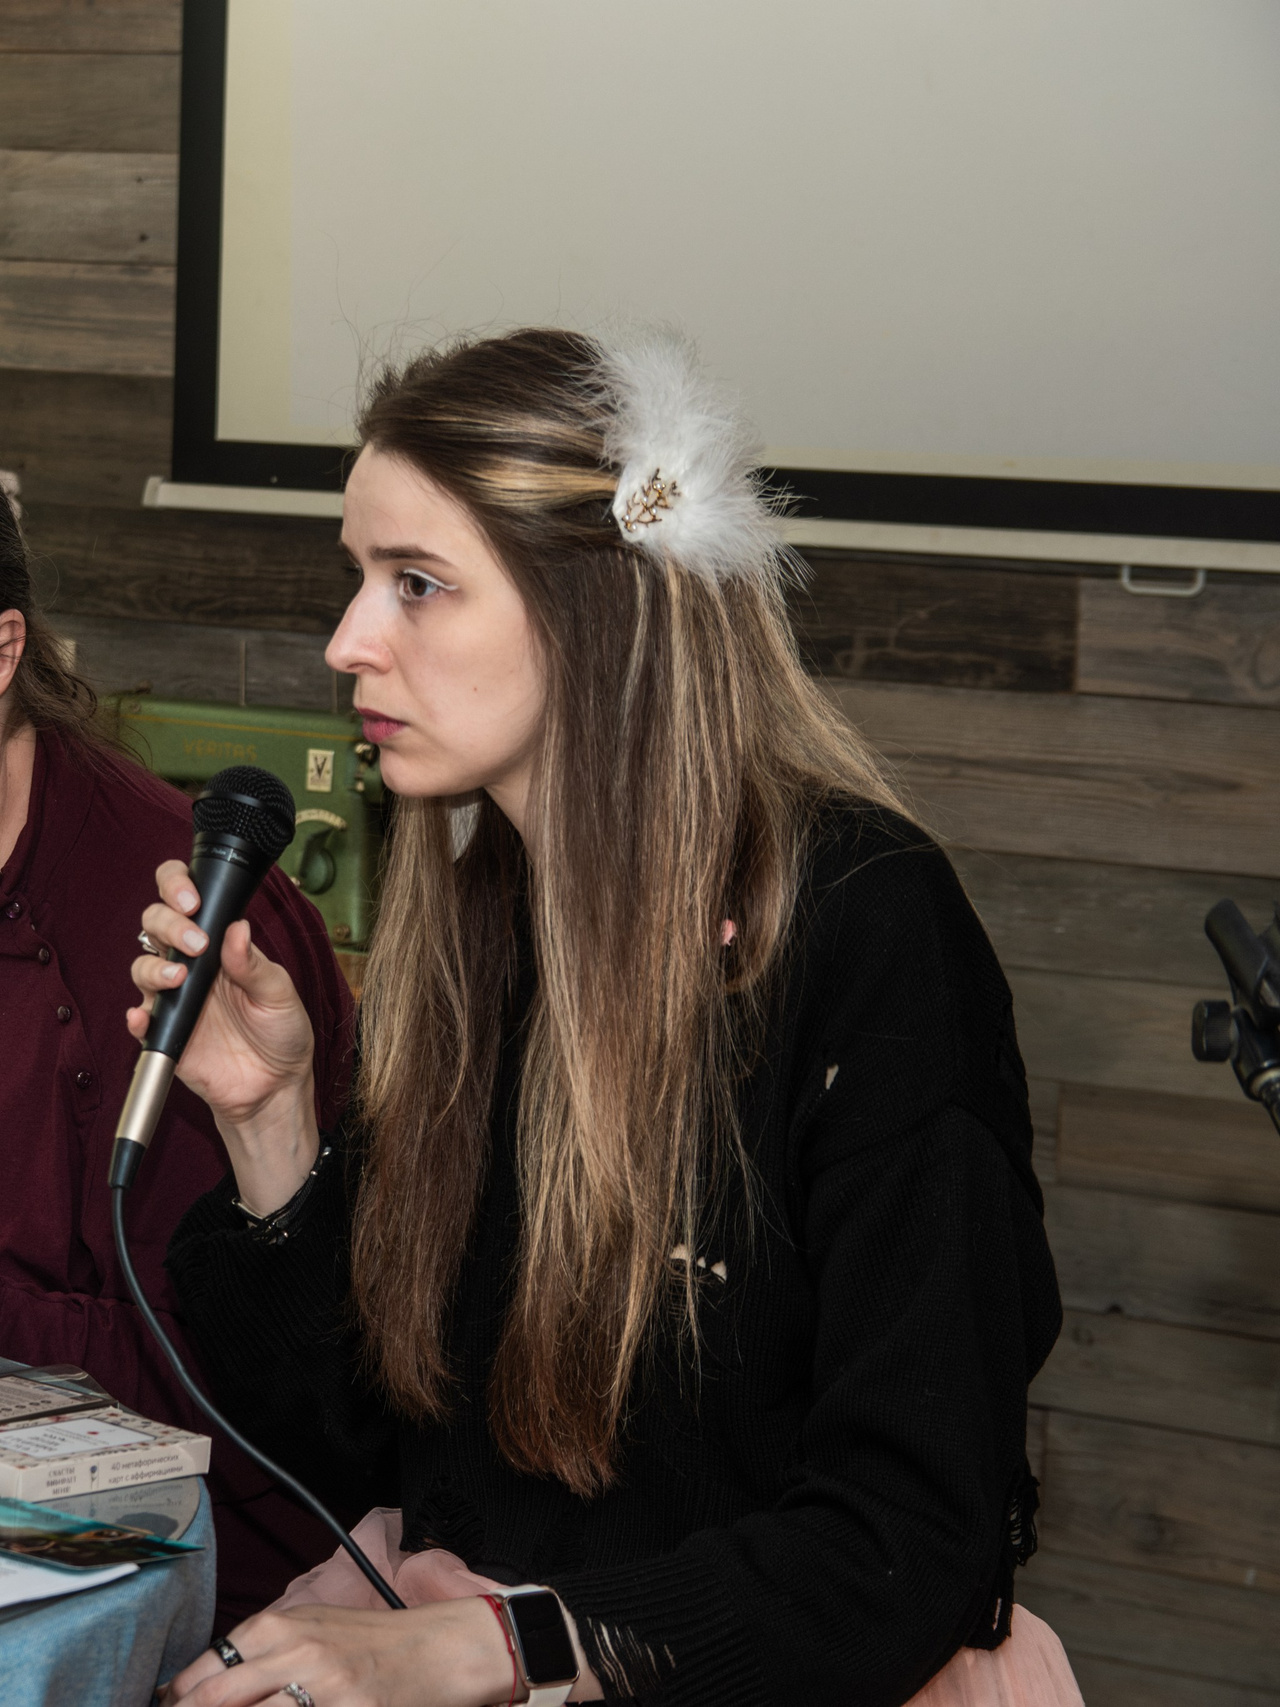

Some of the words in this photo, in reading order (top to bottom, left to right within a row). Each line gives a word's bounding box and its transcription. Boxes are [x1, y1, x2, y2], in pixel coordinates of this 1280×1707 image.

[183, 739, 257, 761] VERITAS
[314, 755, 328, 779] V
[111, 1461, 121, 1471] 40
[121, 1454, 179, 1471] метафорических
[108, 1475, 125, 1485] карт
[130, 1464, 184, 1482] аффирмациями
